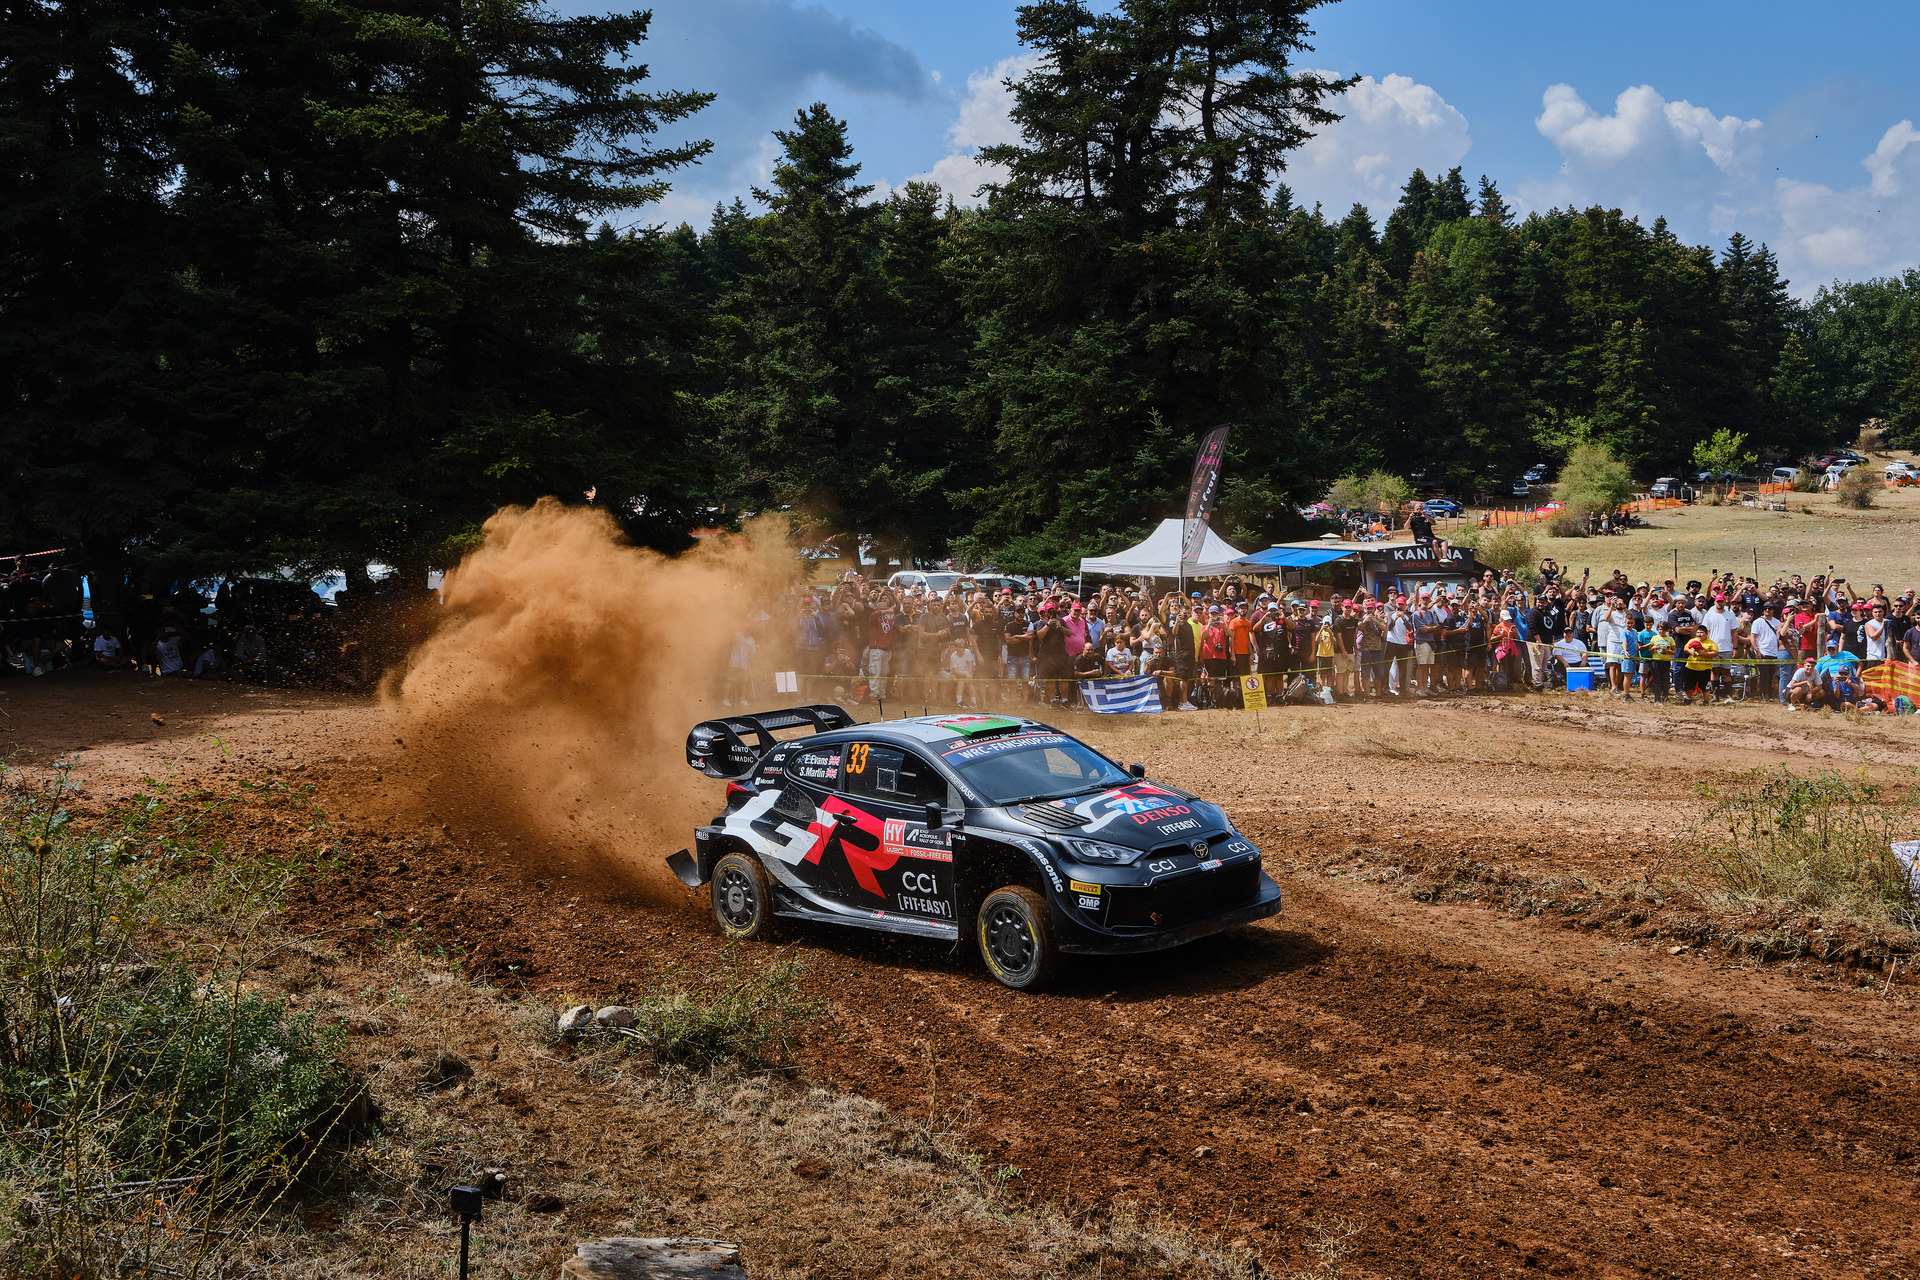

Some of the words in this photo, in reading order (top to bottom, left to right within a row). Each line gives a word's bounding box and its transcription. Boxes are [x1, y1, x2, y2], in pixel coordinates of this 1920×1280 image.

[1393, 547, 1463, 560] KANTNA
[966, 735, 1000, 744] TOYOTA
[731, 744, 749, 753] KINTO
[957, 735, 1069, 759] WRC-FANSHOP.COM
[727, 754, 754, 763] TAMADIC
[804, 754, 829, 766] E.Evans
[846, 743, 870, 774] 33
[799, 766, 826, 778] S.Martin
[1131, 805, 1191, 826] DENSO
[885, 823, 904, 842] HY
[951, 833, 967, 841] PIAA
[910, 849, 942, 860] FOSSIL-FREE
[1015, 839, 1064, 893] Panasonic
[1072, 882, 1099, 893] PIRELLI
[1078, 897, 1100, 908] OMP
